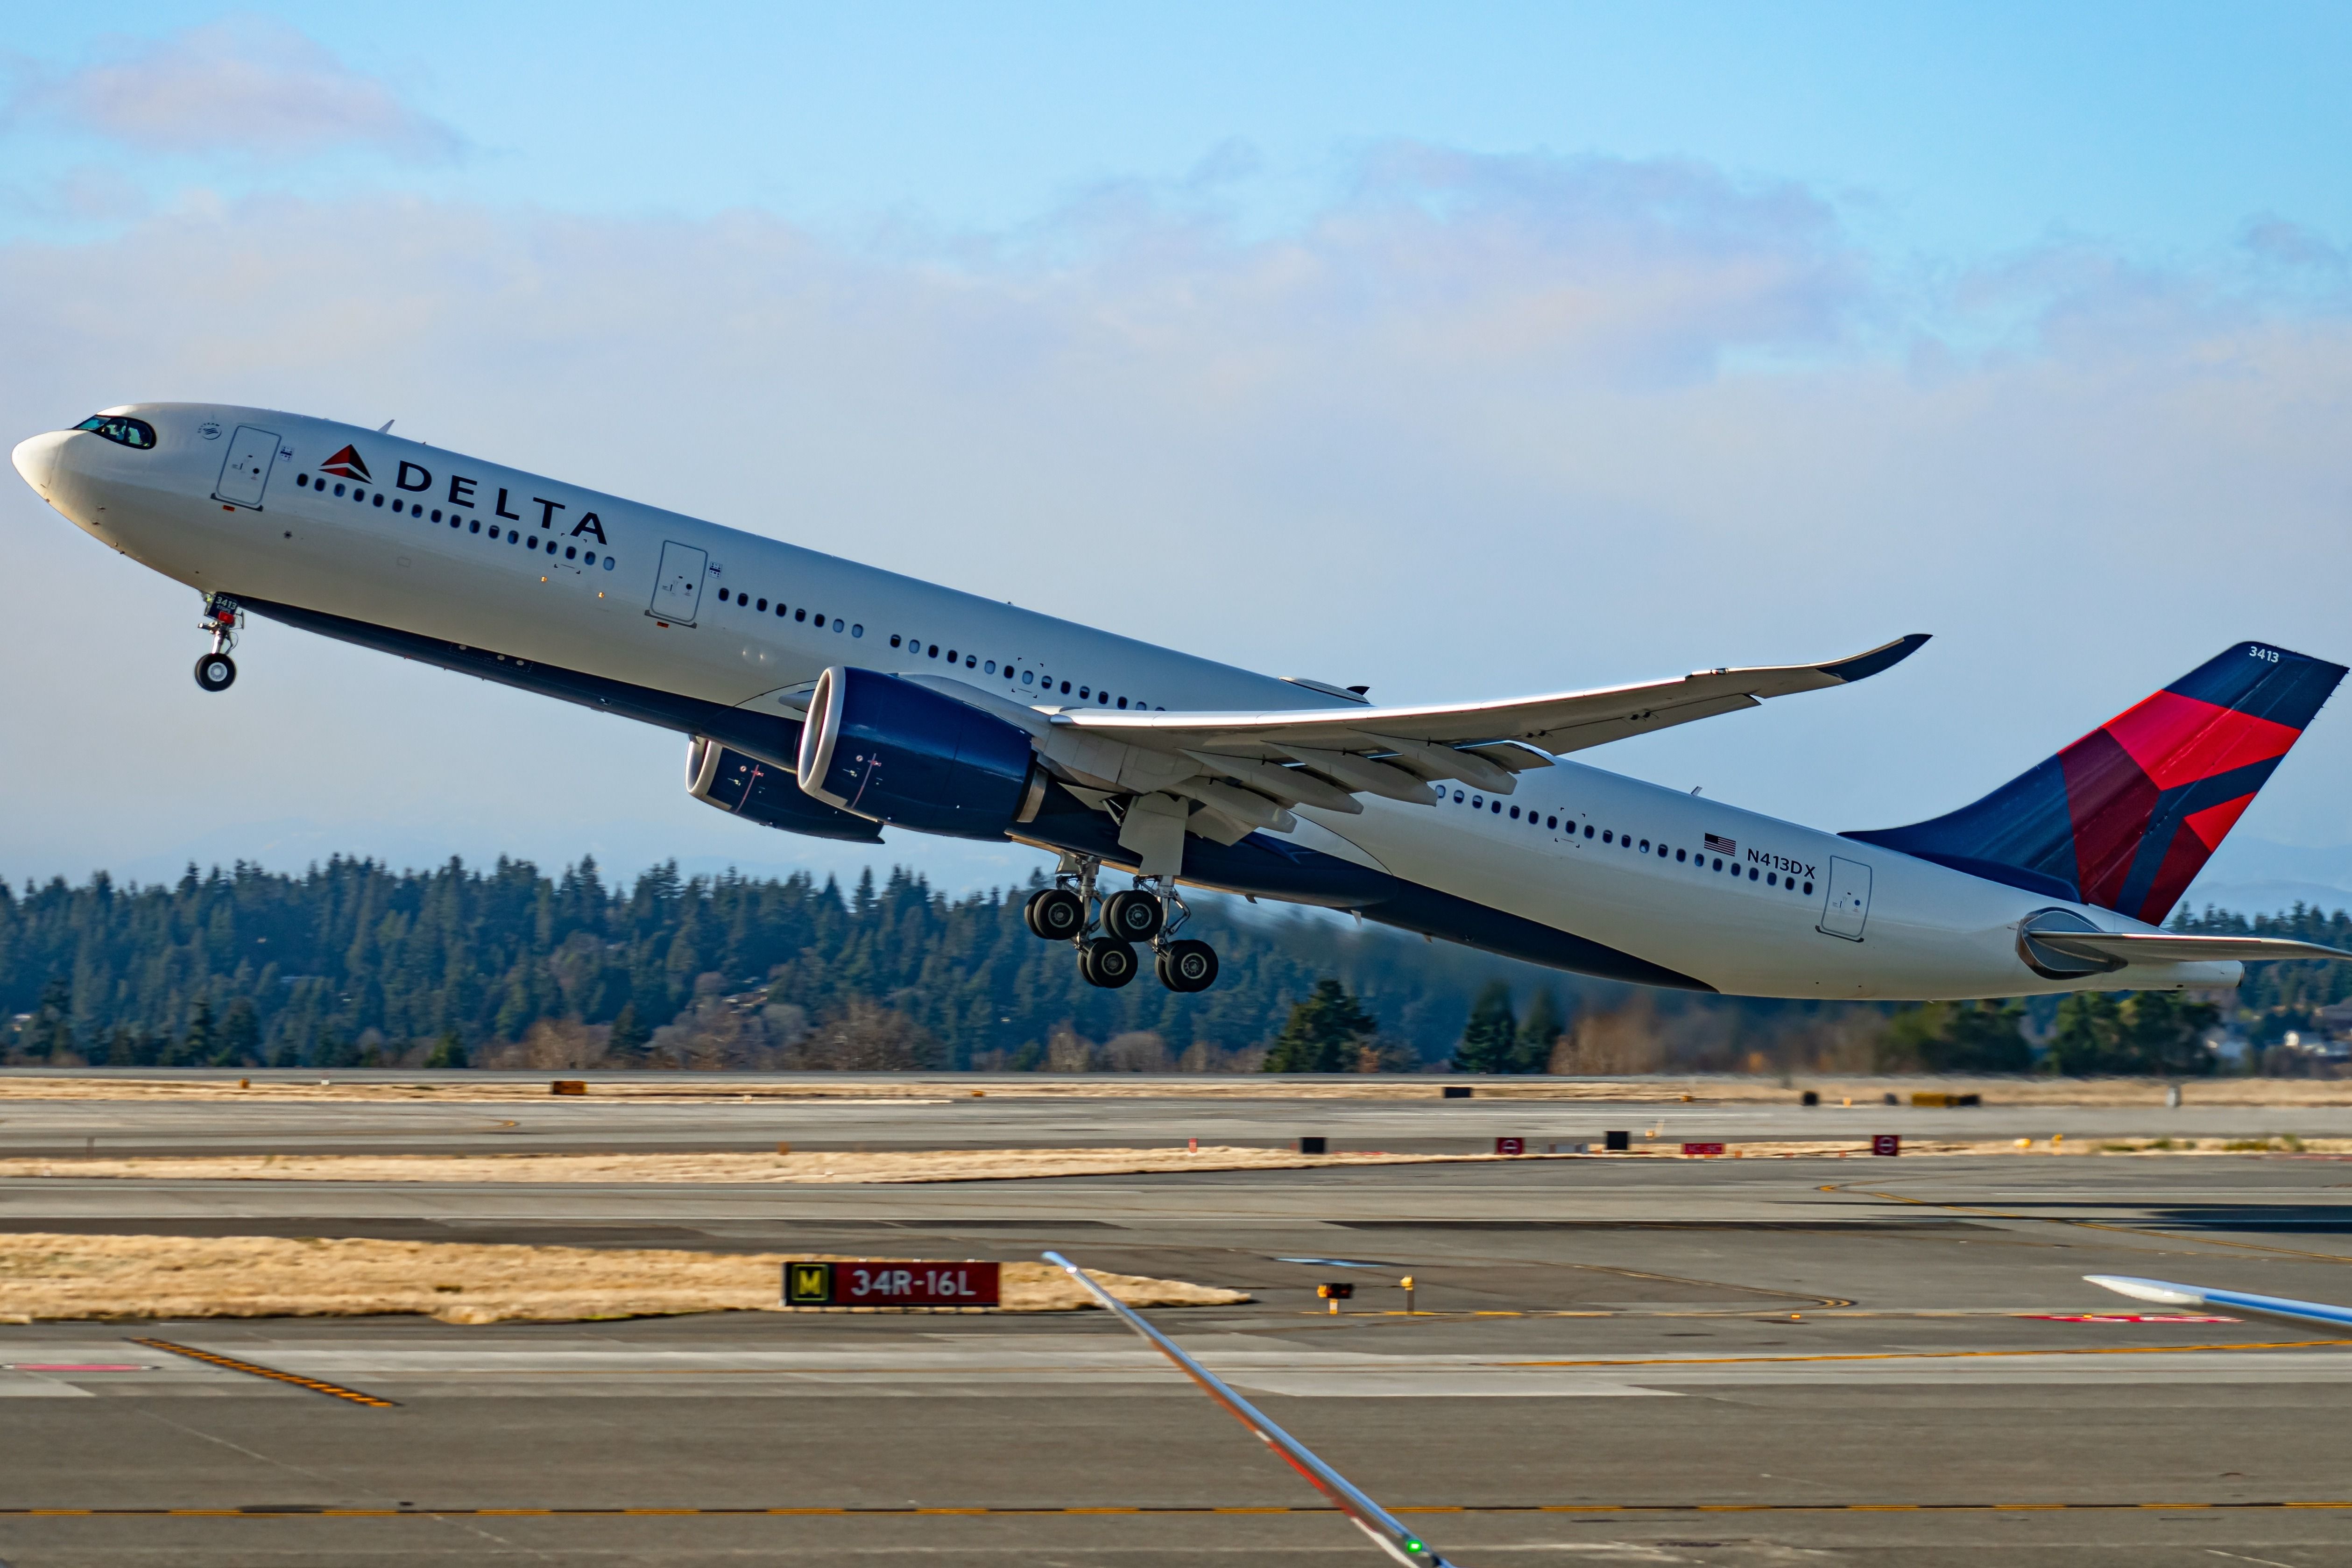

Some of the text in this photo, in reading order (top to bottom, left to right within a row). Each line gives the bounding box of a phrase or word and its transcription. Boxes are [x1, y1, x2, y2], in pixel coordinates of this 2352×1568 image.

[396, 460, 607, 545] DELTA
[216, 596, 237, 610] 3413
[2249, 646, 2279, 663] 3413
[1747, 848, 1816, 879] N413DX
[798, 1270, 977, 1296] M 34R-16L
